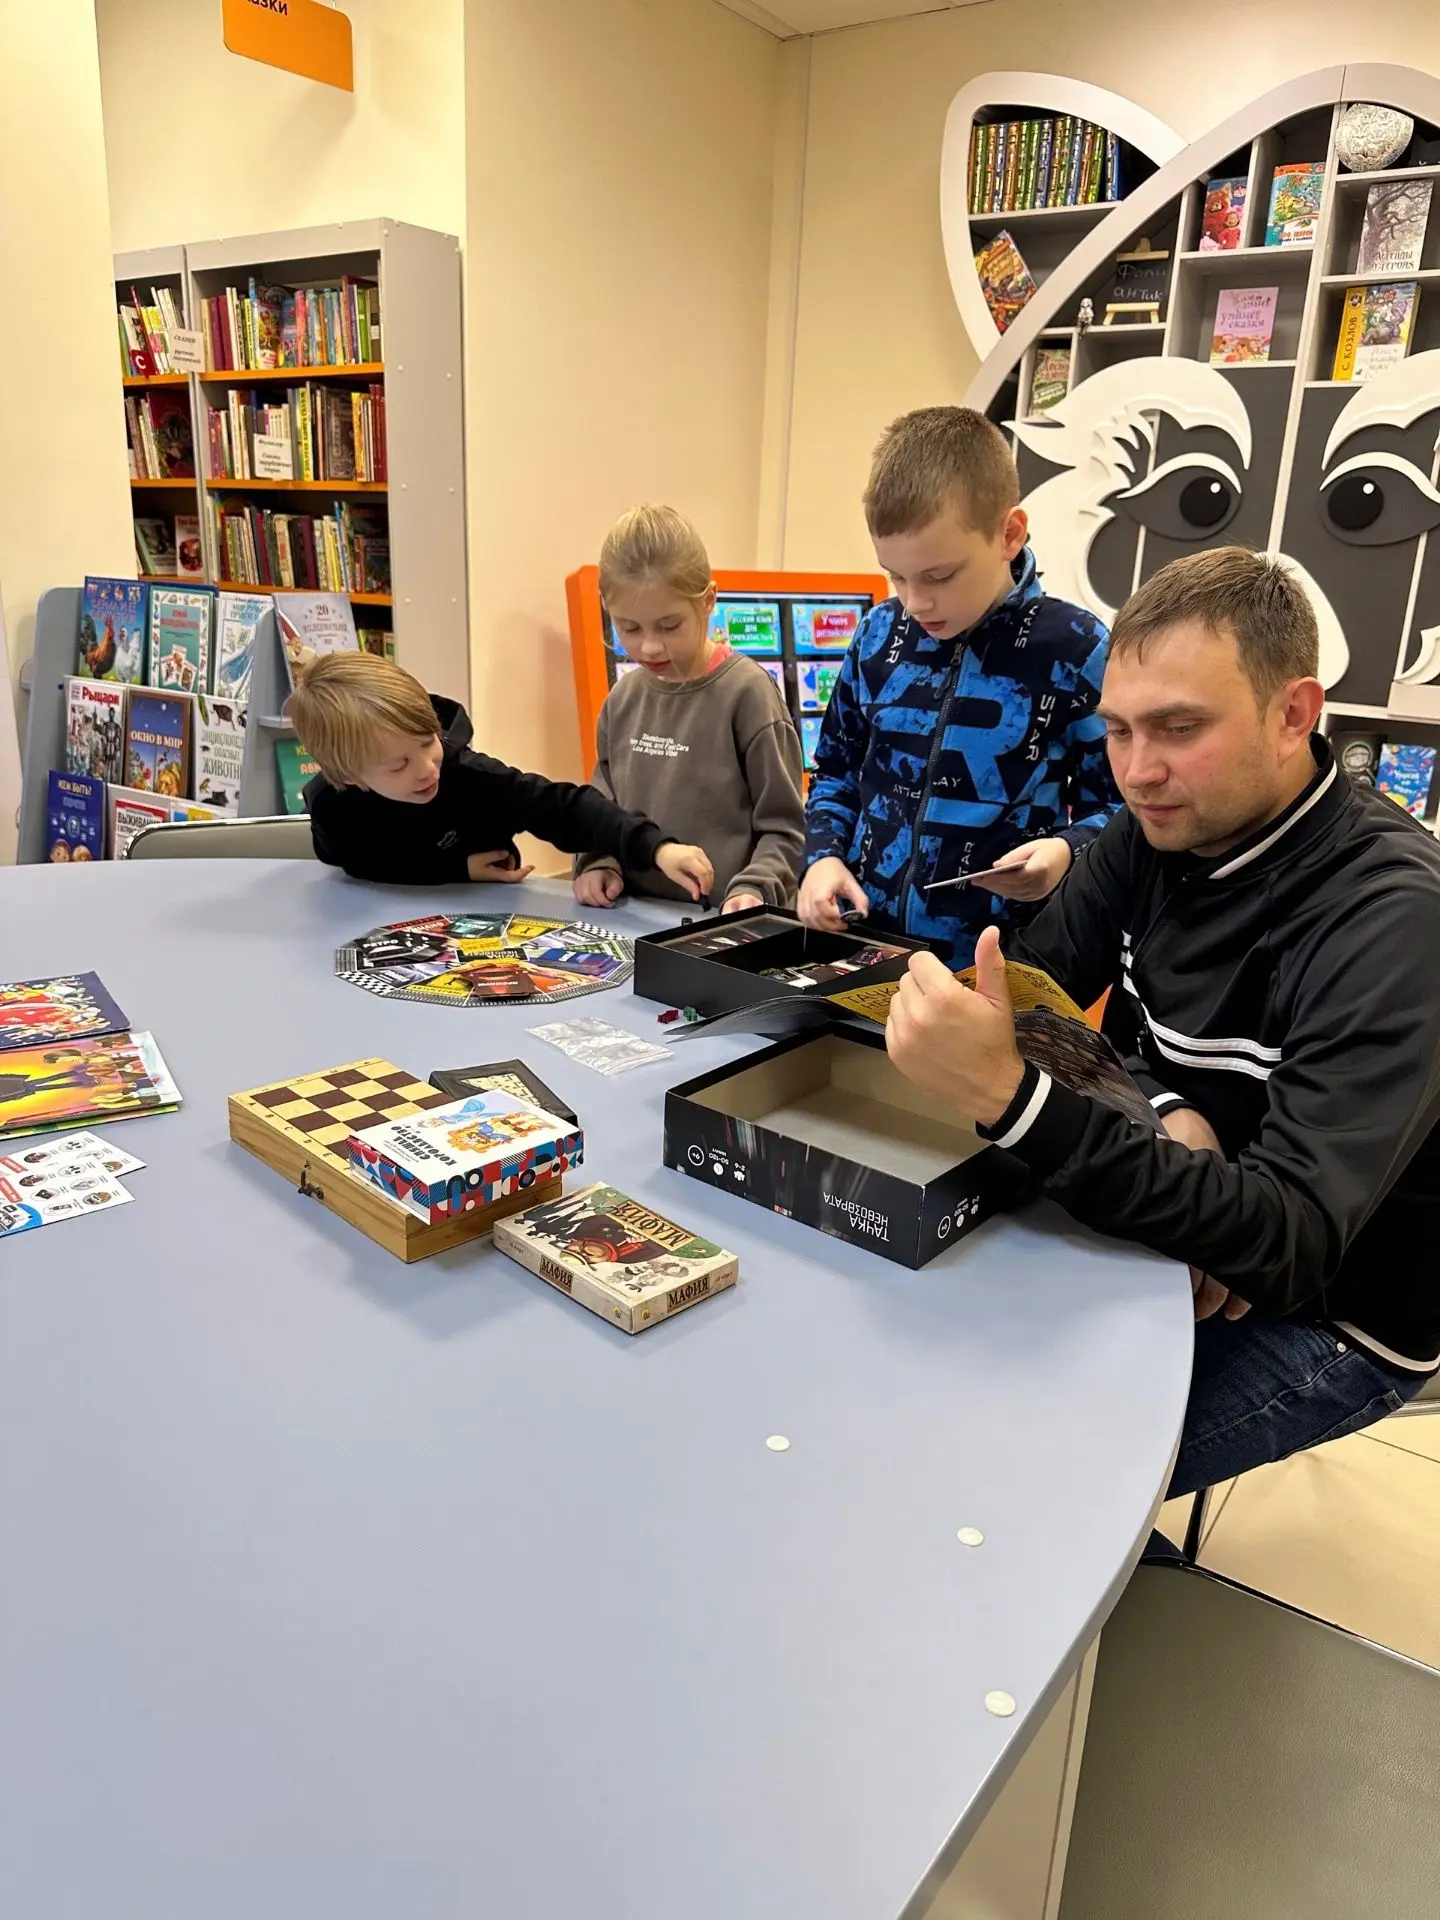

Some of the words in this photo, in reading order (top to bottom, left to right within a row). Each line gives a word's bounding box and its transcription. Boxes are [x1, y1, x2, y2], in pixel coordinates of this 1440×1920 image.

[1344, 316, 1357, 358] КОЗЛОВ
[316, 604, 329, 616] 20
[821, 615, 848, 625] Учим
[886, 608, 911, 664] STAR
[82, 686, 120, 706] Рыцари
[131, 730, 156, 745] ОКНО
[156, 735, 163, 745] В
[163, 737, 183, 749] МИР
[1025, 693, 1056, 761] STAR
[644, 747, 664, 756] Angeles
[362, 938, 399, 949] РЕТРО
[841, 985, 900, 1003] ТАЧК
[391, 1126, 457, 1167] КОРОЛЕВСТВО
[823, 1192, 889, 1227] НЕВОЗВРАТА
[612, 1203, 691, 1247] МАФИЯ
[849, 1213, 890, 1242] ТАЧКА
[541, 1257, 573, 1288] МАФИЯ
[668, 1276, 709, 1308] МАФИЯ
